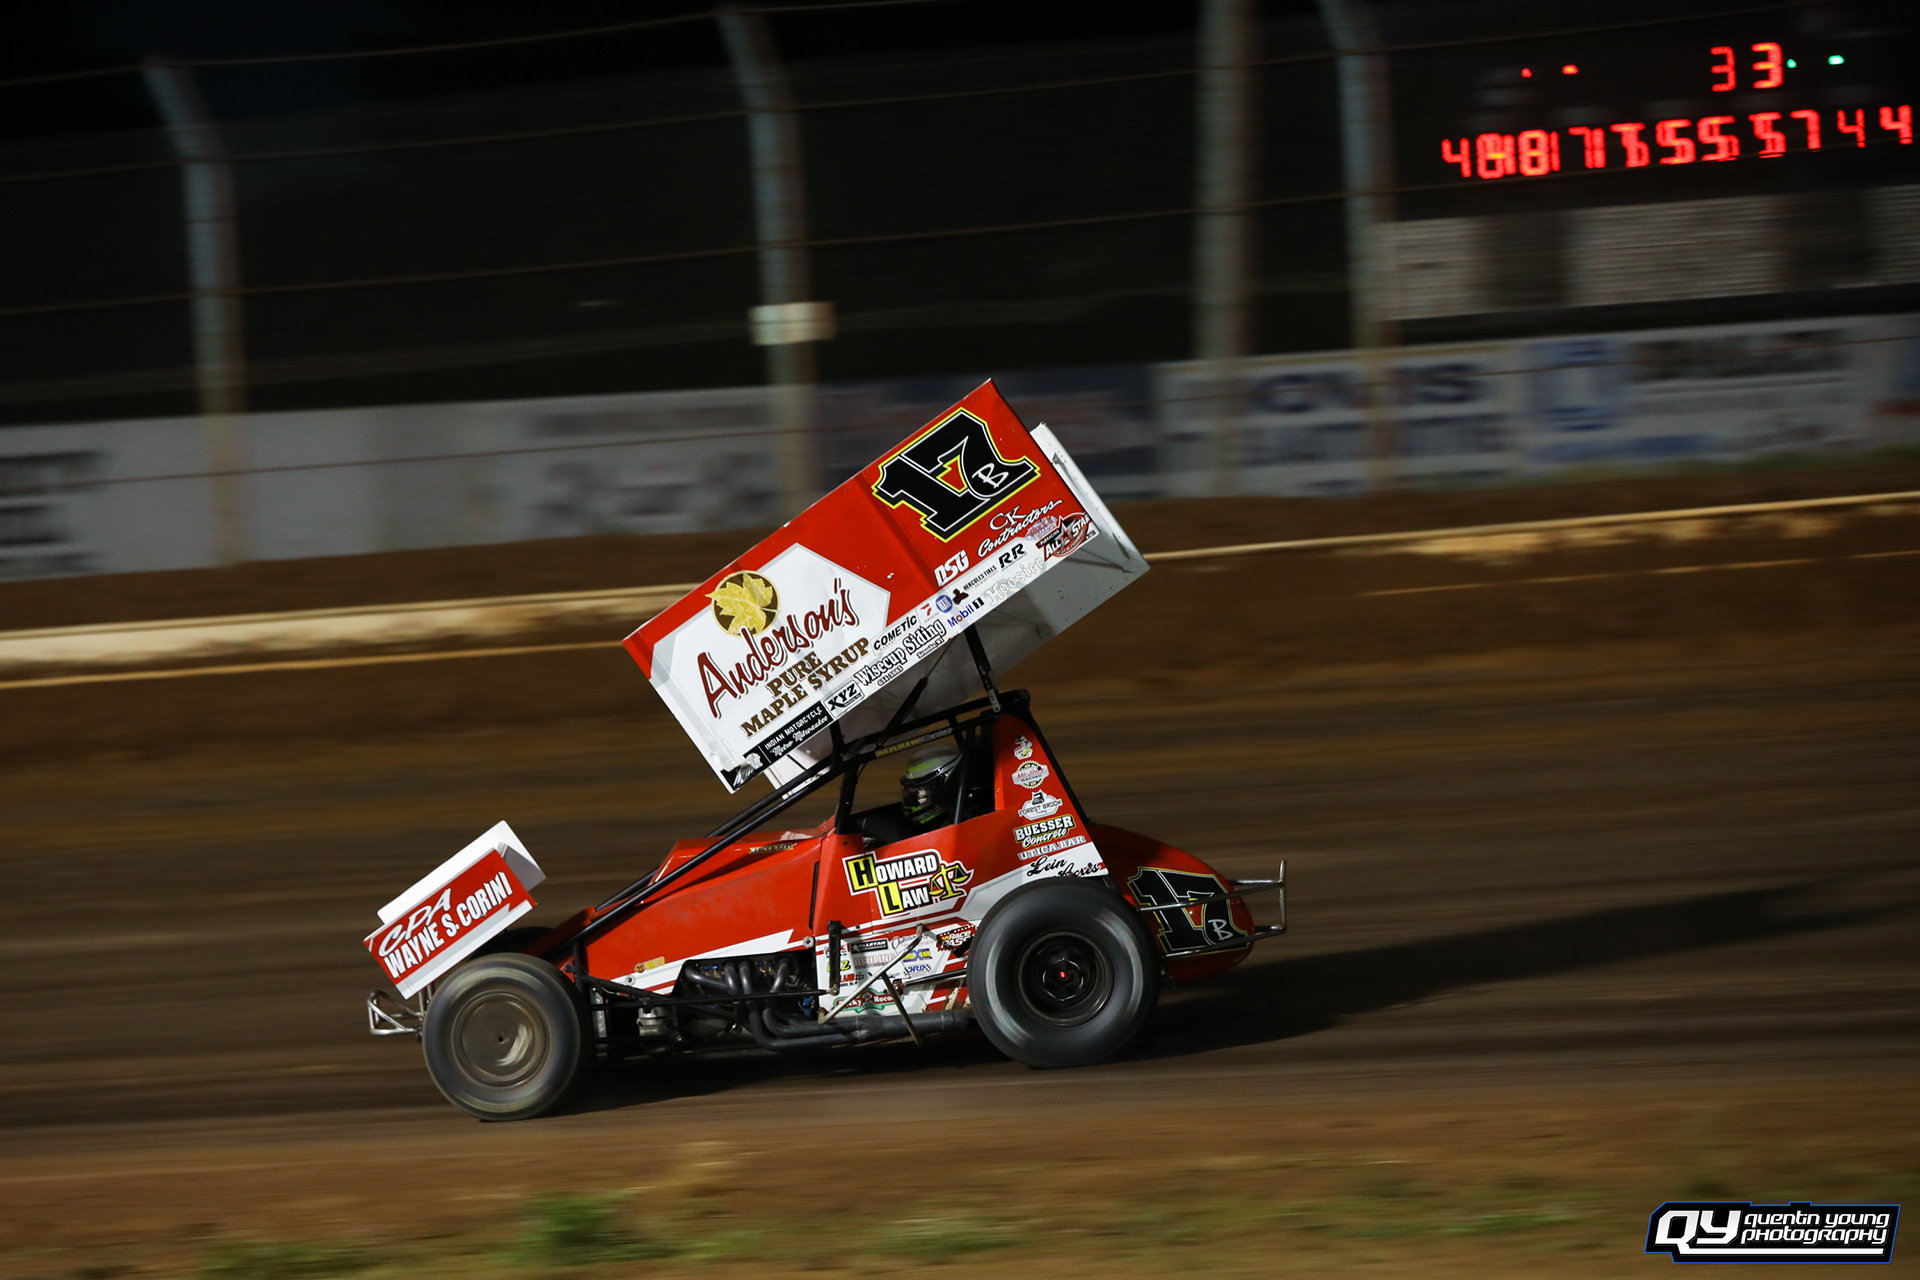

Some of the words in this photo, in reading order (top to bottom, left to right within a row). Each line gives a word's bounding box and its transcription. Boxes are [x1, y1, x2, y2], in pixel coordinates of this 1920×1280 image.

[977, 499, 1063, 557] Contractors
[989, 505, 1027, 530] CK
[998, 543, 1026, 568] RR
[984, 557, 1045, 606] Hoosier
[947, 604, 975, 627] Mobil
[972, 597, 984, 609] 1
[697, 578, 860, 718] Anderson's
[873, 615, 918, 650] COMETIC
[853, 647, 908, 686] Wisecup
[902, 619, 947, 655] Siding
[740, 683, 808, 739] MAPLE
[807, 637, 870, 691] SYRUP
[766, 651, 822, 698] PURE
[828, 683, 857, 711] XYZ
[764, 733, 785, 750] INDIAN
[784, 706, 823, 736] MOTORCYCLE
[1014, 816, 1073, 841] BUESSER
[1022, 828, 1068, 848] Concrete
[852, 854, 938, 890] HOWARD
[1027, 855, 1067, 876] Lein
[883, 884, 930, 913] LAW
[378, 888, 451, 957] CPA
[383, 921, 445, 979] WAYNE
[441, 912, 460, 937] S.
[456, 871, 513, 927] CORINI
